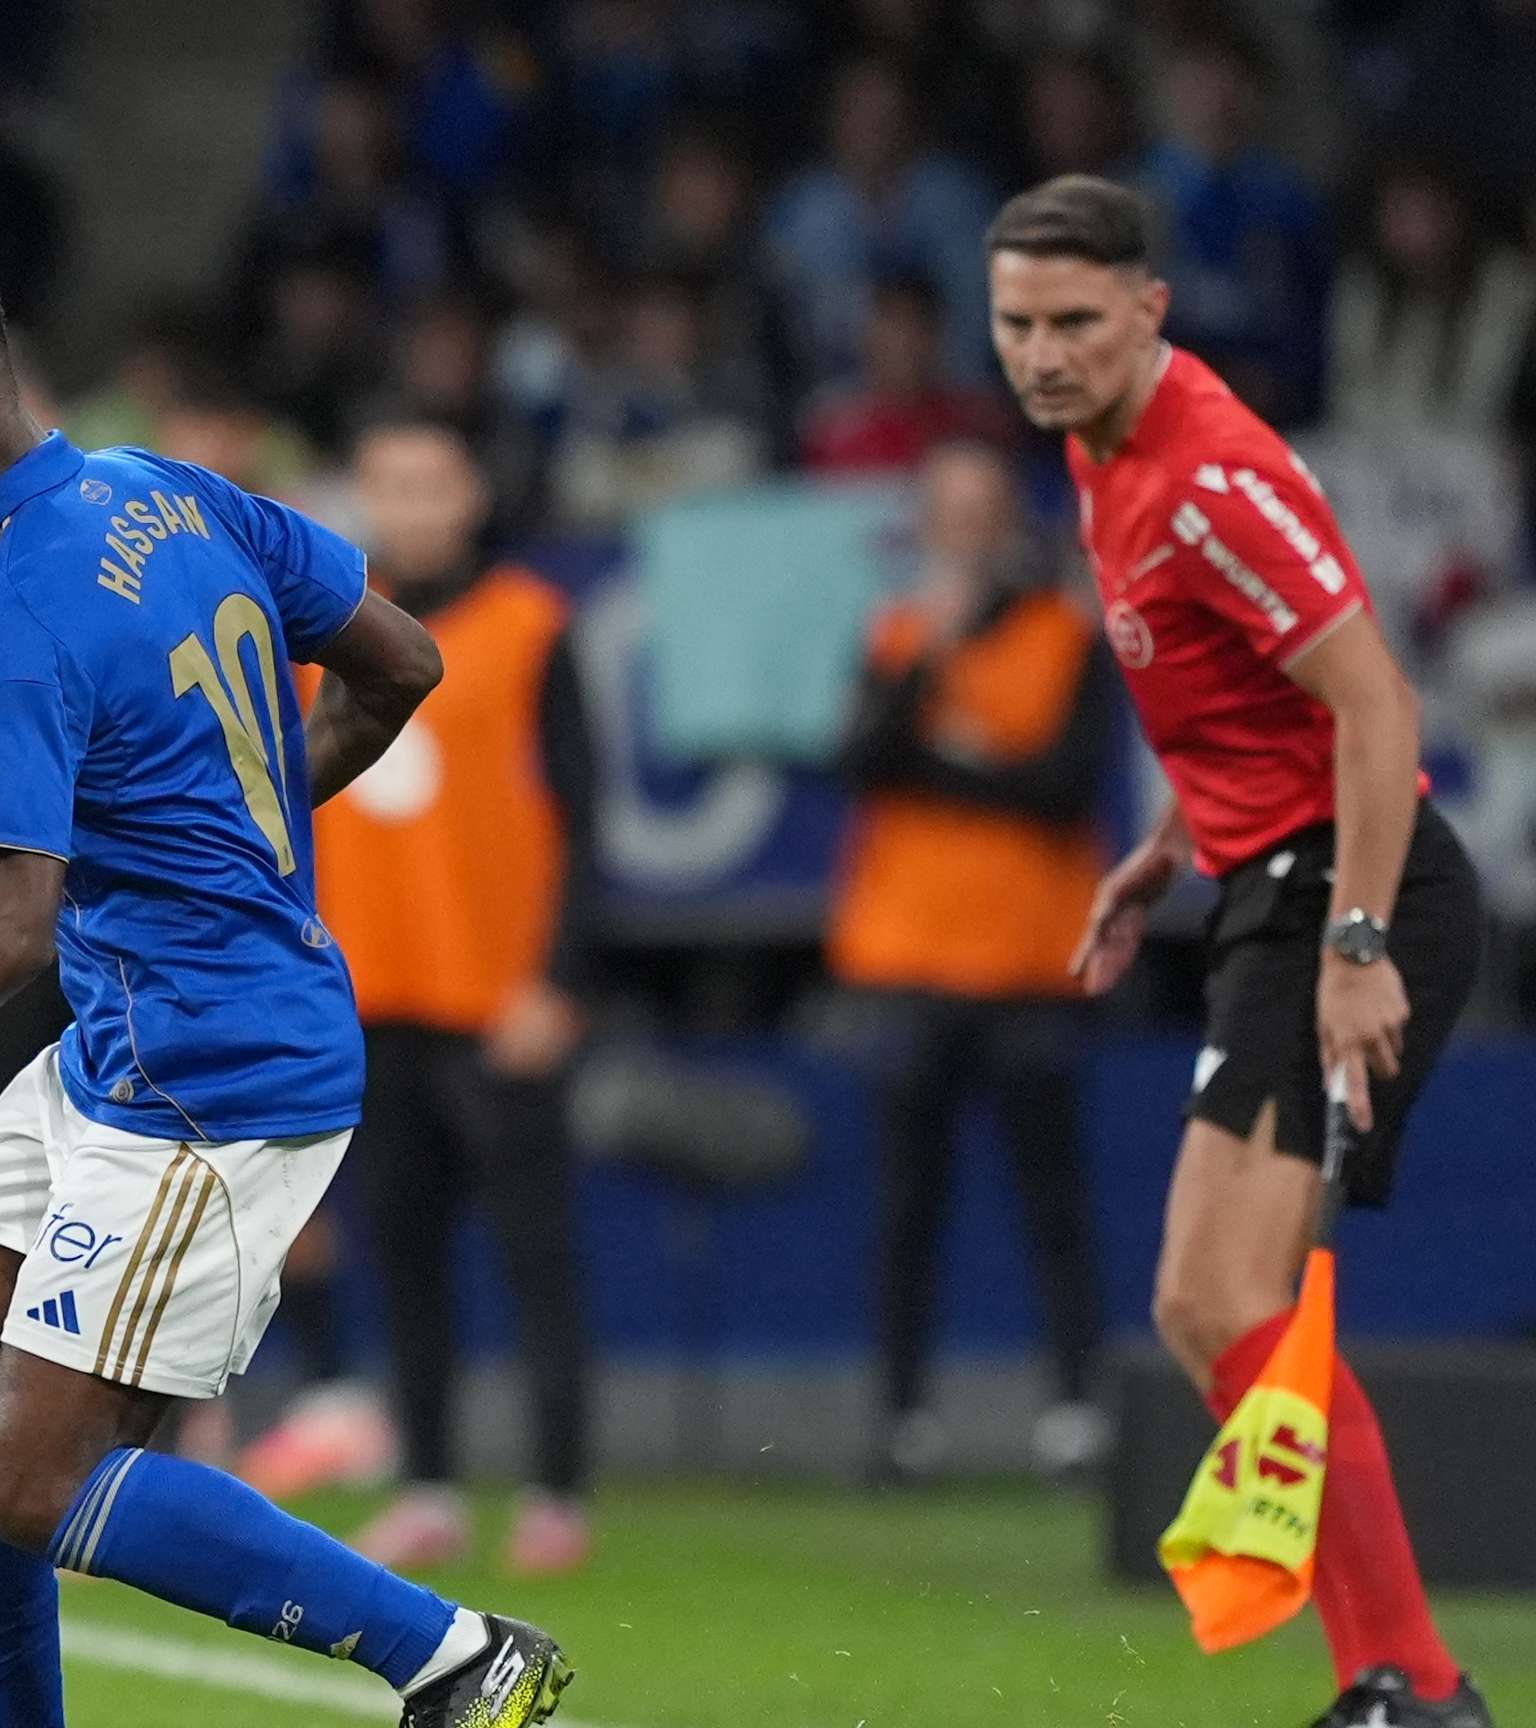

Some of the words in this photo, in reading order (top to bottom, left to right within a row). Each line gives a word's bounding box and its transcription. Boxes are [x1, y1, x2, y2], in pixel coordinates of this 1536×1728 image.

[97, 491, 210, 605] HASSAN
[169, 592, 296, 879] 10
[268, 1600, 305, 1642] 26
